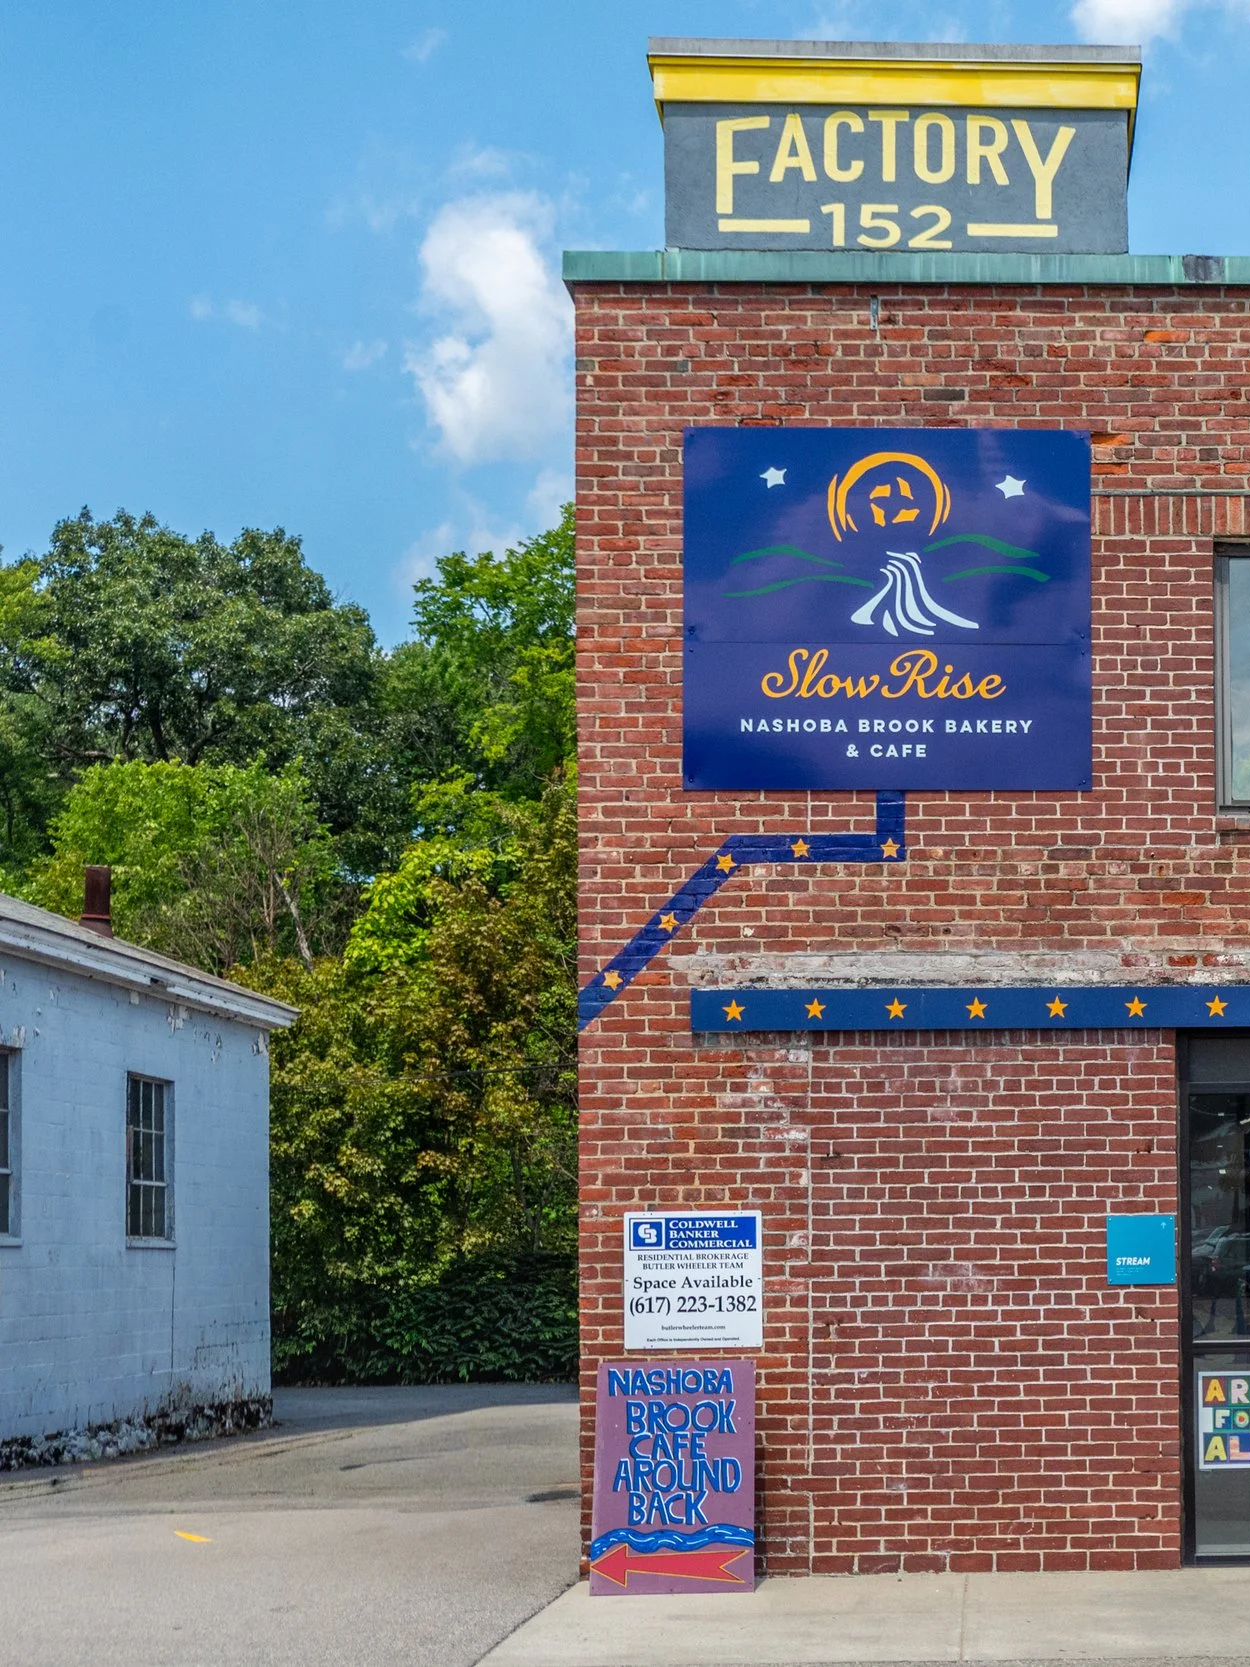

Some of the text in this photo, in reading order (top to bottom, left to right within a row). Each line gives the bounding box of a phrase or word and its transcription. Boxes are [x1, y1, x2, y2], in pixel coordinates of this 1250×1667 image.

[715, 110, 1076, 219] FACTORY
[820, 203, 952, 249] 152
[761, 648, 1006, 699] Slow Rise
[740, 718, 1034, 734] NASHOBA BROOK BAKERY
[845, 744, 928, 758] & CAFE
[669, 1220, 738, 1229] COLDWELL
[669, 1230, 719, 1238] BANKER
[669, 1239, 753, 1248] COMMERCIAL
[637, 1253, 695, 1261] RESIDENTIAL
[676, 1262, 717, 1270] WHEELER
[1115, 1256, 1151, 1266] STREAM
[633, 1275, 753, 1293] Space Available
[629, 1295, 757, 1316] (617) 223-1382
[608, 1368, 734, 1396] NASHOBA
[626, 1400, 737, 1434] BROOK
[629, 1432, 708, 1460] CAFE
[612, 1457, 742, 1493] AROUND
[628, 1490, 708, 1526] BACK
